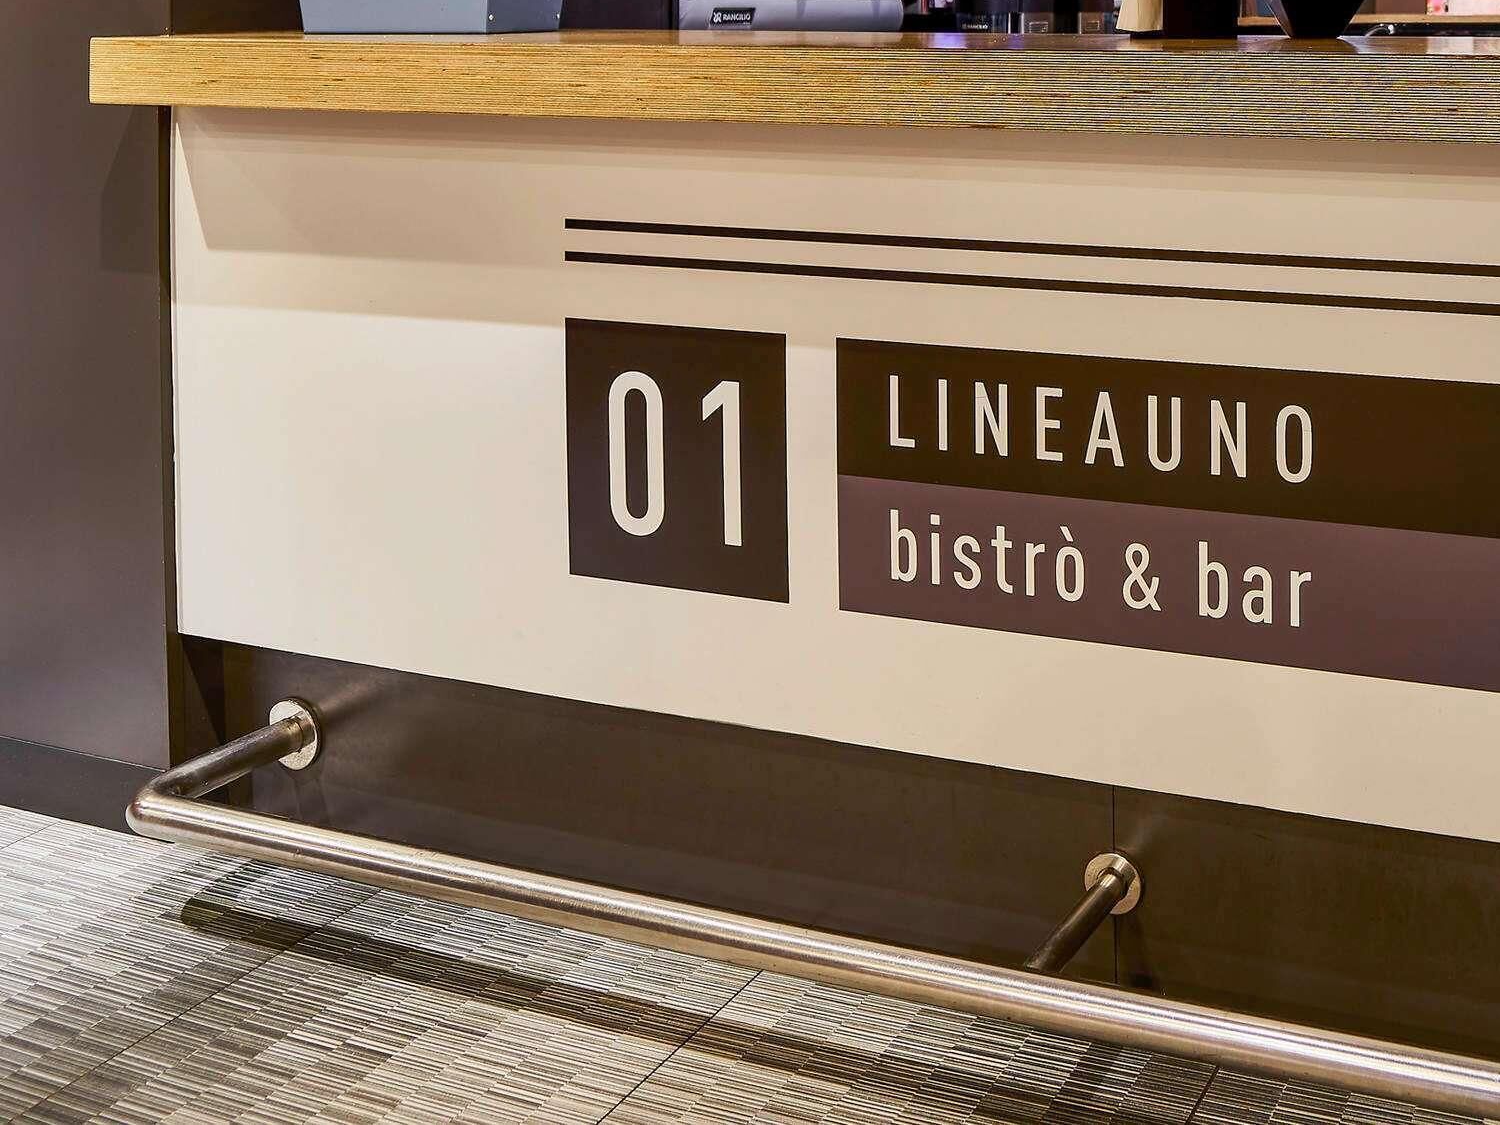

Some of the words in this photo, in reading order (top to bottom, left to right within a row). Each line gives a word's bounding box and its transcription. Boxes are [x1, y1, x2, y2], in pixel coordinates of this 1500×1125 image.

[607, 371, 743, 547] 01
[888, 373, 1314, 484] LINEAUNO
[889, 507, 1086, 603] bistrò
[1121, 541, 1163, 613] &
[1197, 539, 1313, 629] bar
